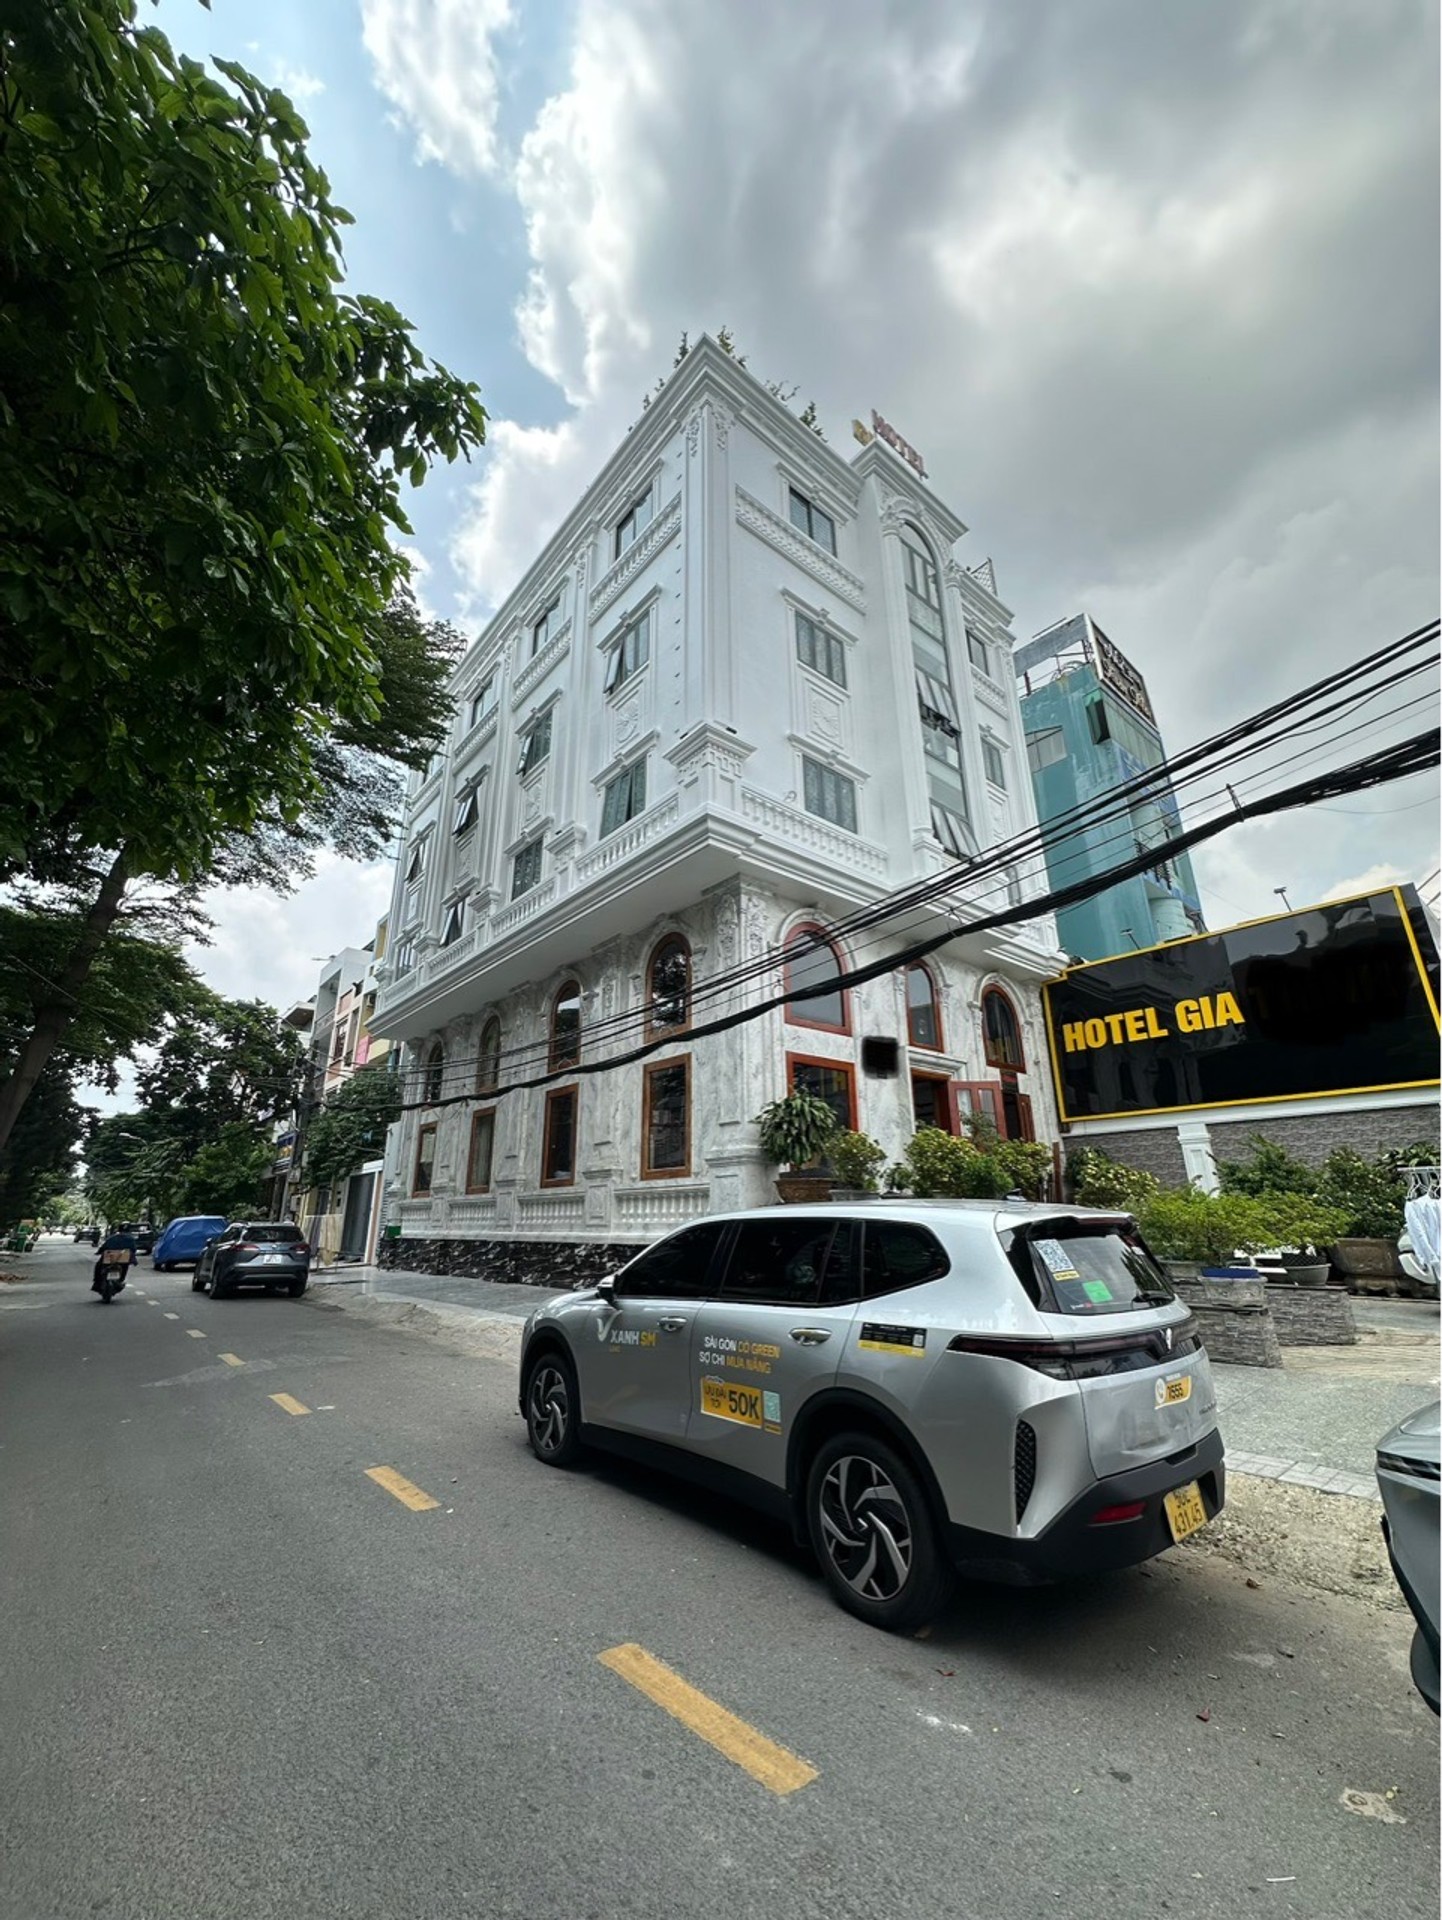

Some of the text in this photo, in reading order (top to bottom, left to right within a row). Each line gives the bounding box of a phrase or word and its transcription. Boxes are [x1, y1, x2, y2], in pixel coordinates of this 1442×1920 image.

[1062, 1007, 1169, 1052] HOTEL
[1174, 991, 1246, 1034] GIA
[610, 1329, 640, 1345] XANH
[729, 1389, 760, 1420] 50K
